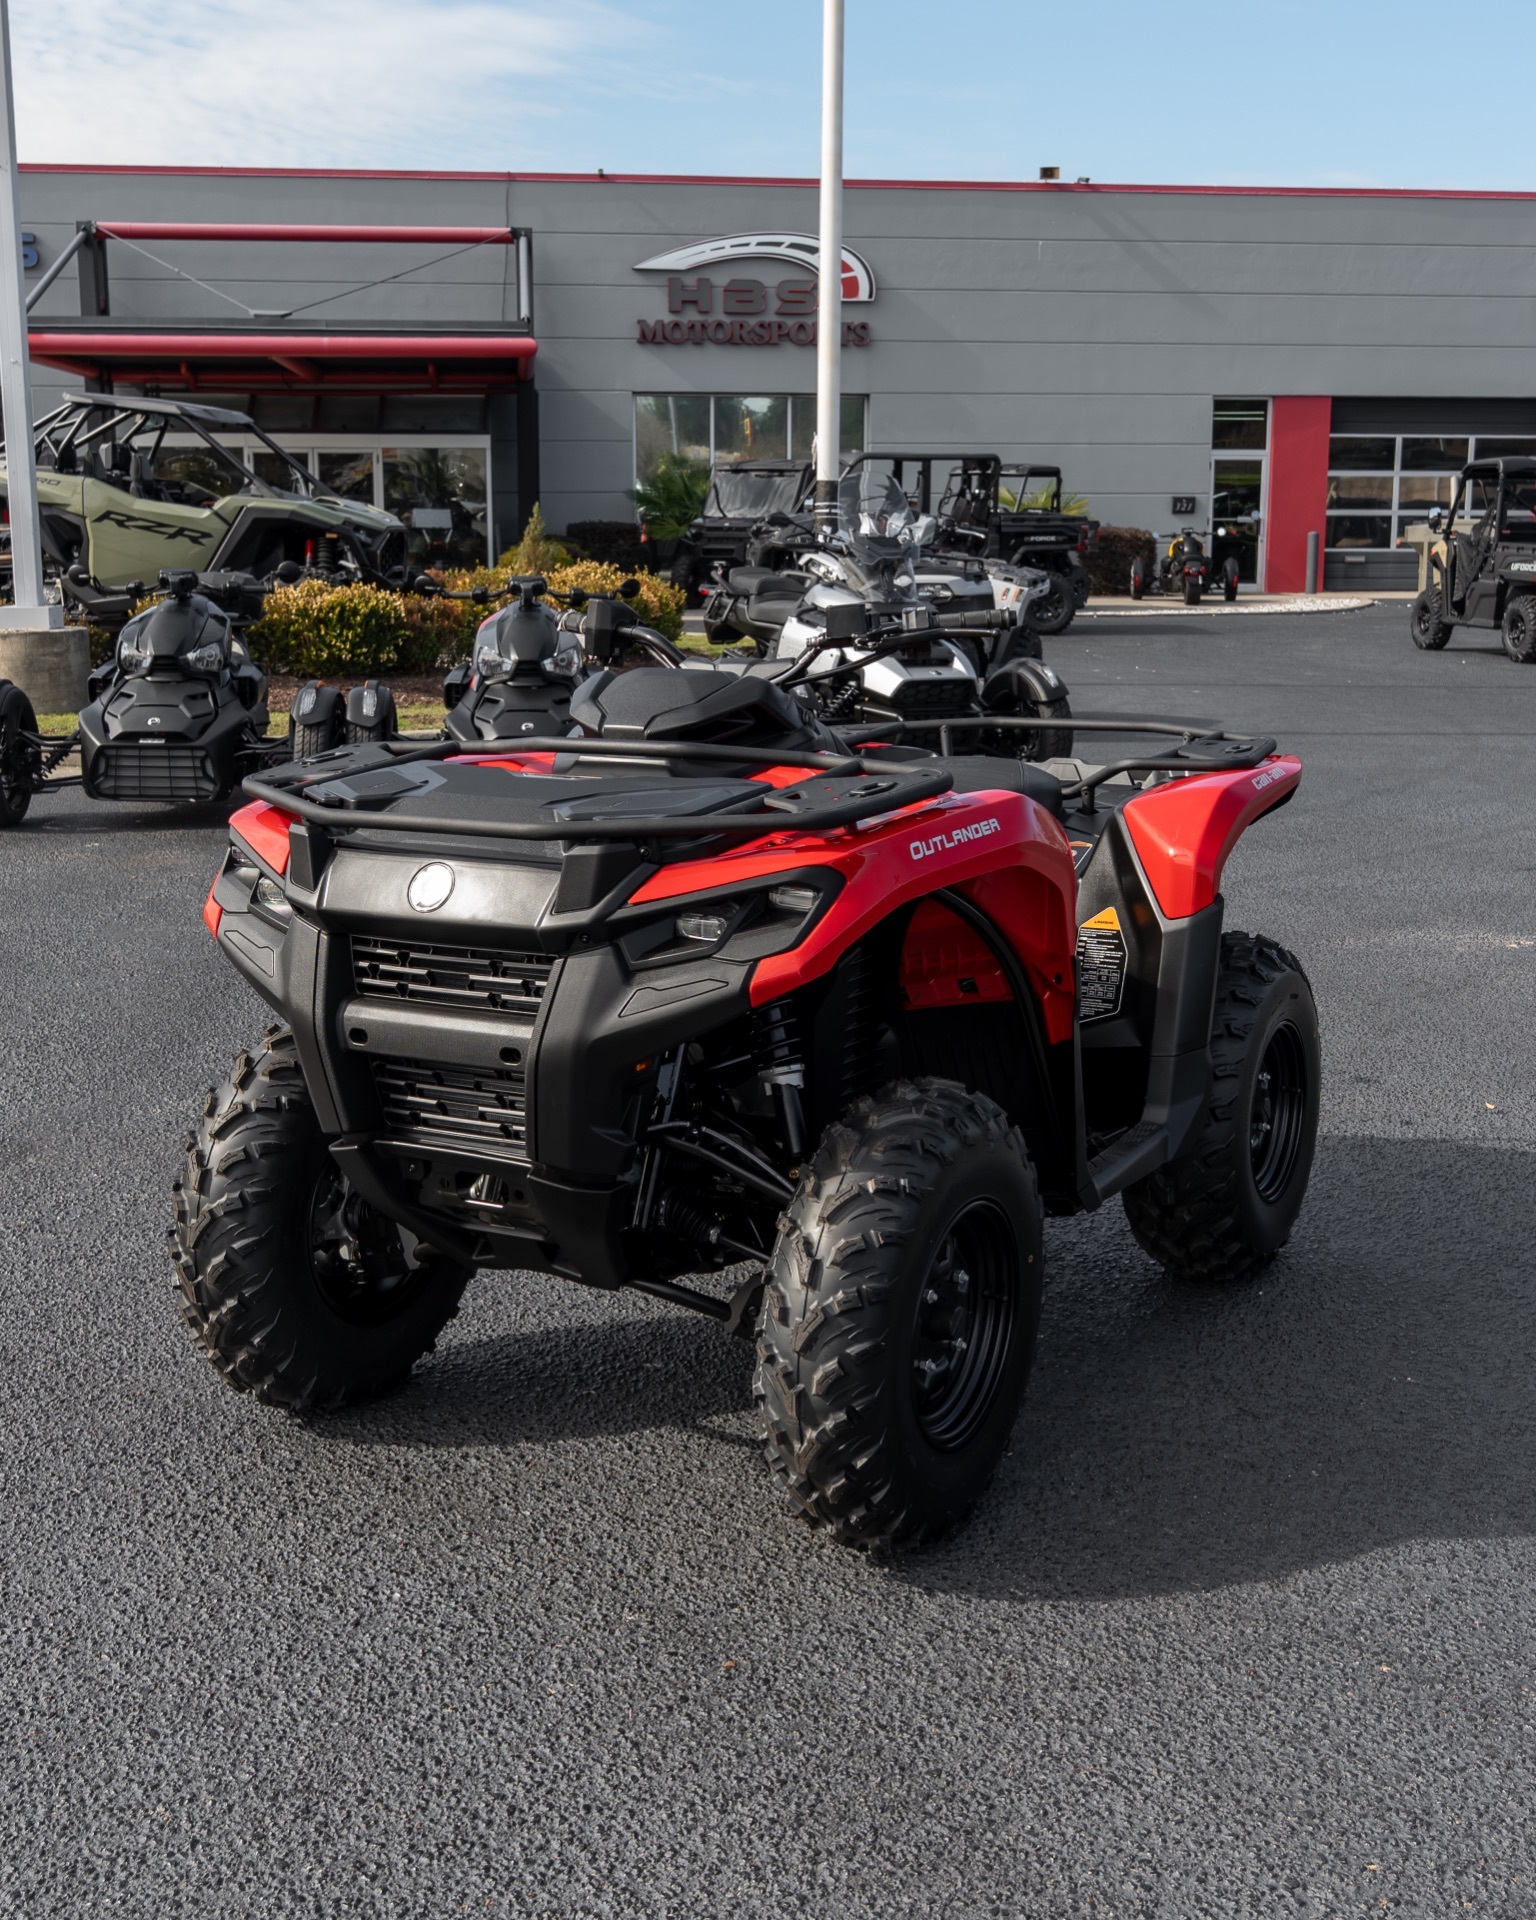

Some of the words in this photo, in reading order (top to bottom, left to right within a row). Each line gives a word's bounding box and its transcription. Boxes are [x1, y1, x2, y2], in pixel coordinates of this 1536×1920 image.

[667, 277, 820, 315] HBS
[636, 319, 872, 347] MOTORSPOTS
[92, 509, 215, 547] RZR
[909, 818, 1001, 861] OUTLANDER
